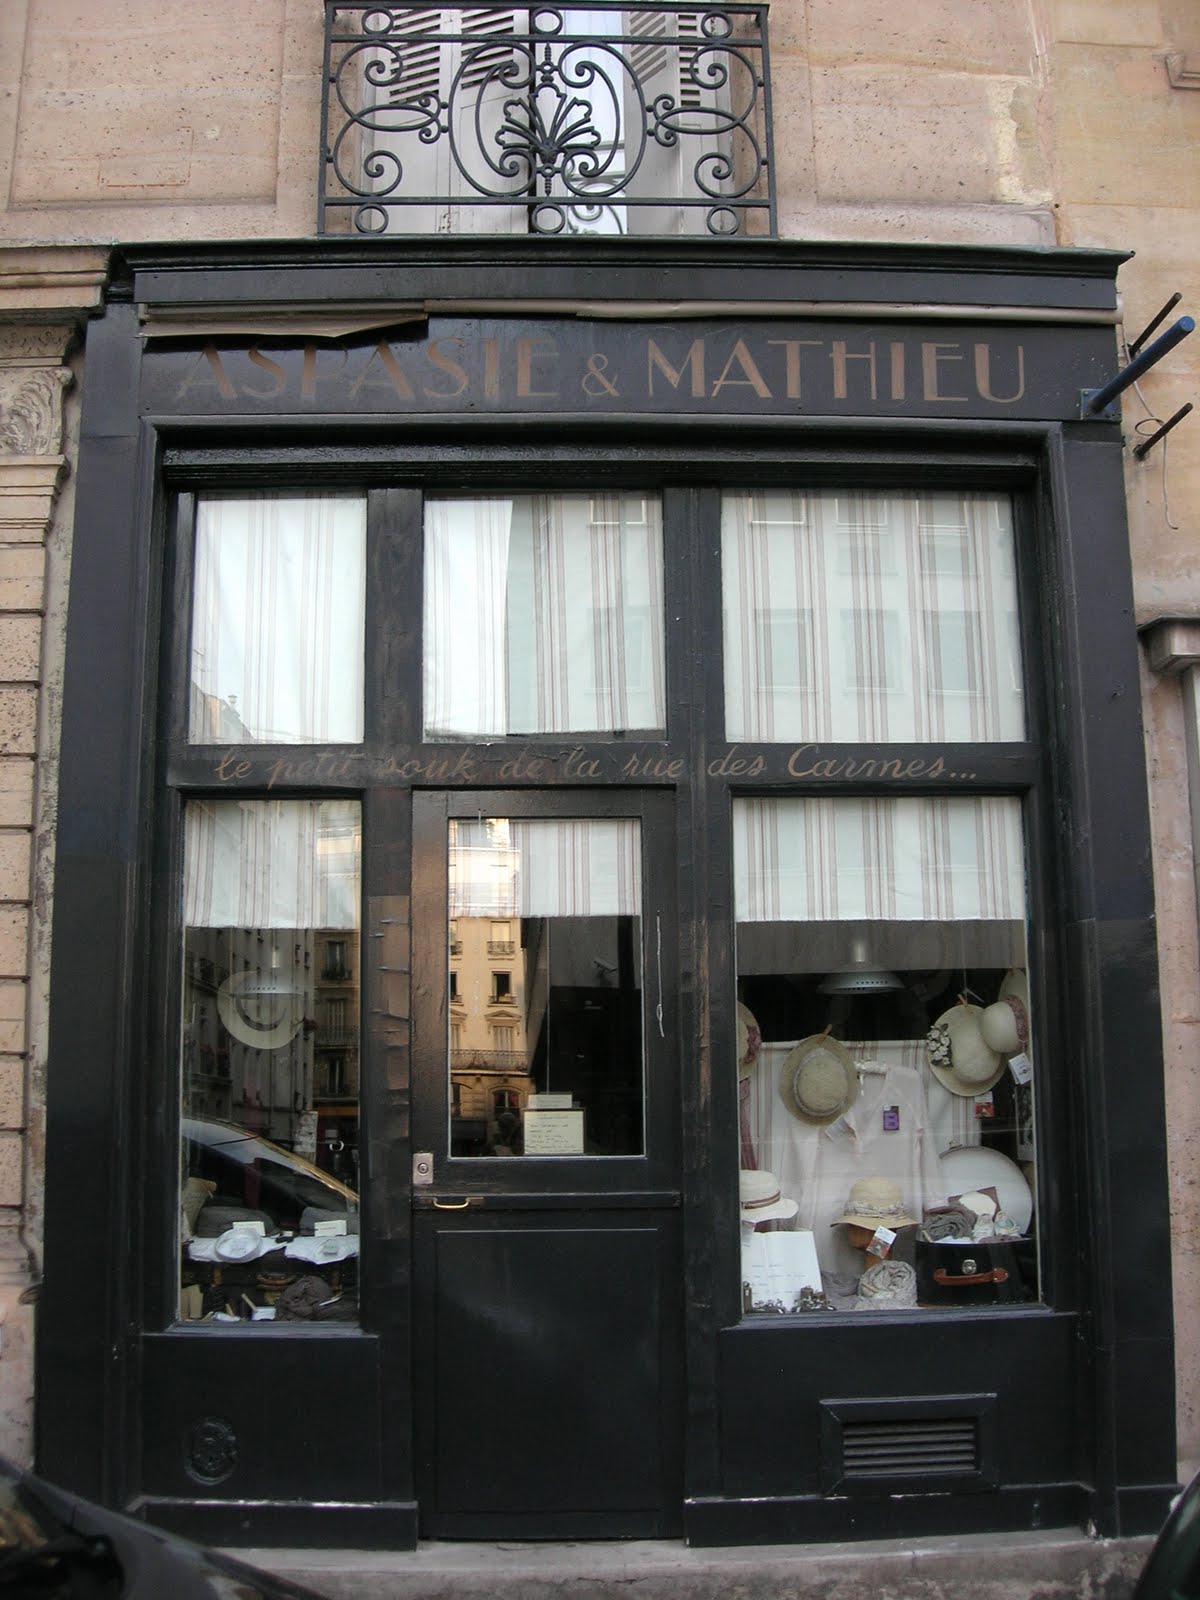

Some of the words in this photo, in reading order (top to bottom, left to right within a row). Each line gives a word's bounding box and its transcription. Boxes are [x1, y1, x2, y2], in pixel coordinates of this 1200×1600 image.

[176, 336, 560, 400] ASPASIE
[581, 353, 619, 397] &
[648, 337, 1025, 403] MATHIEU
[214, 750, 253, 781] le
[265, 751, 366, 790] petit
[376, 748, 478, 780] souk
[499, 745, 545, 779] de
[563, 745, 602, 778] la
[622, 752, 684, 778] rue
[707, 746, 767, 778] des
[787, 744, 977, 779] Carmes...
